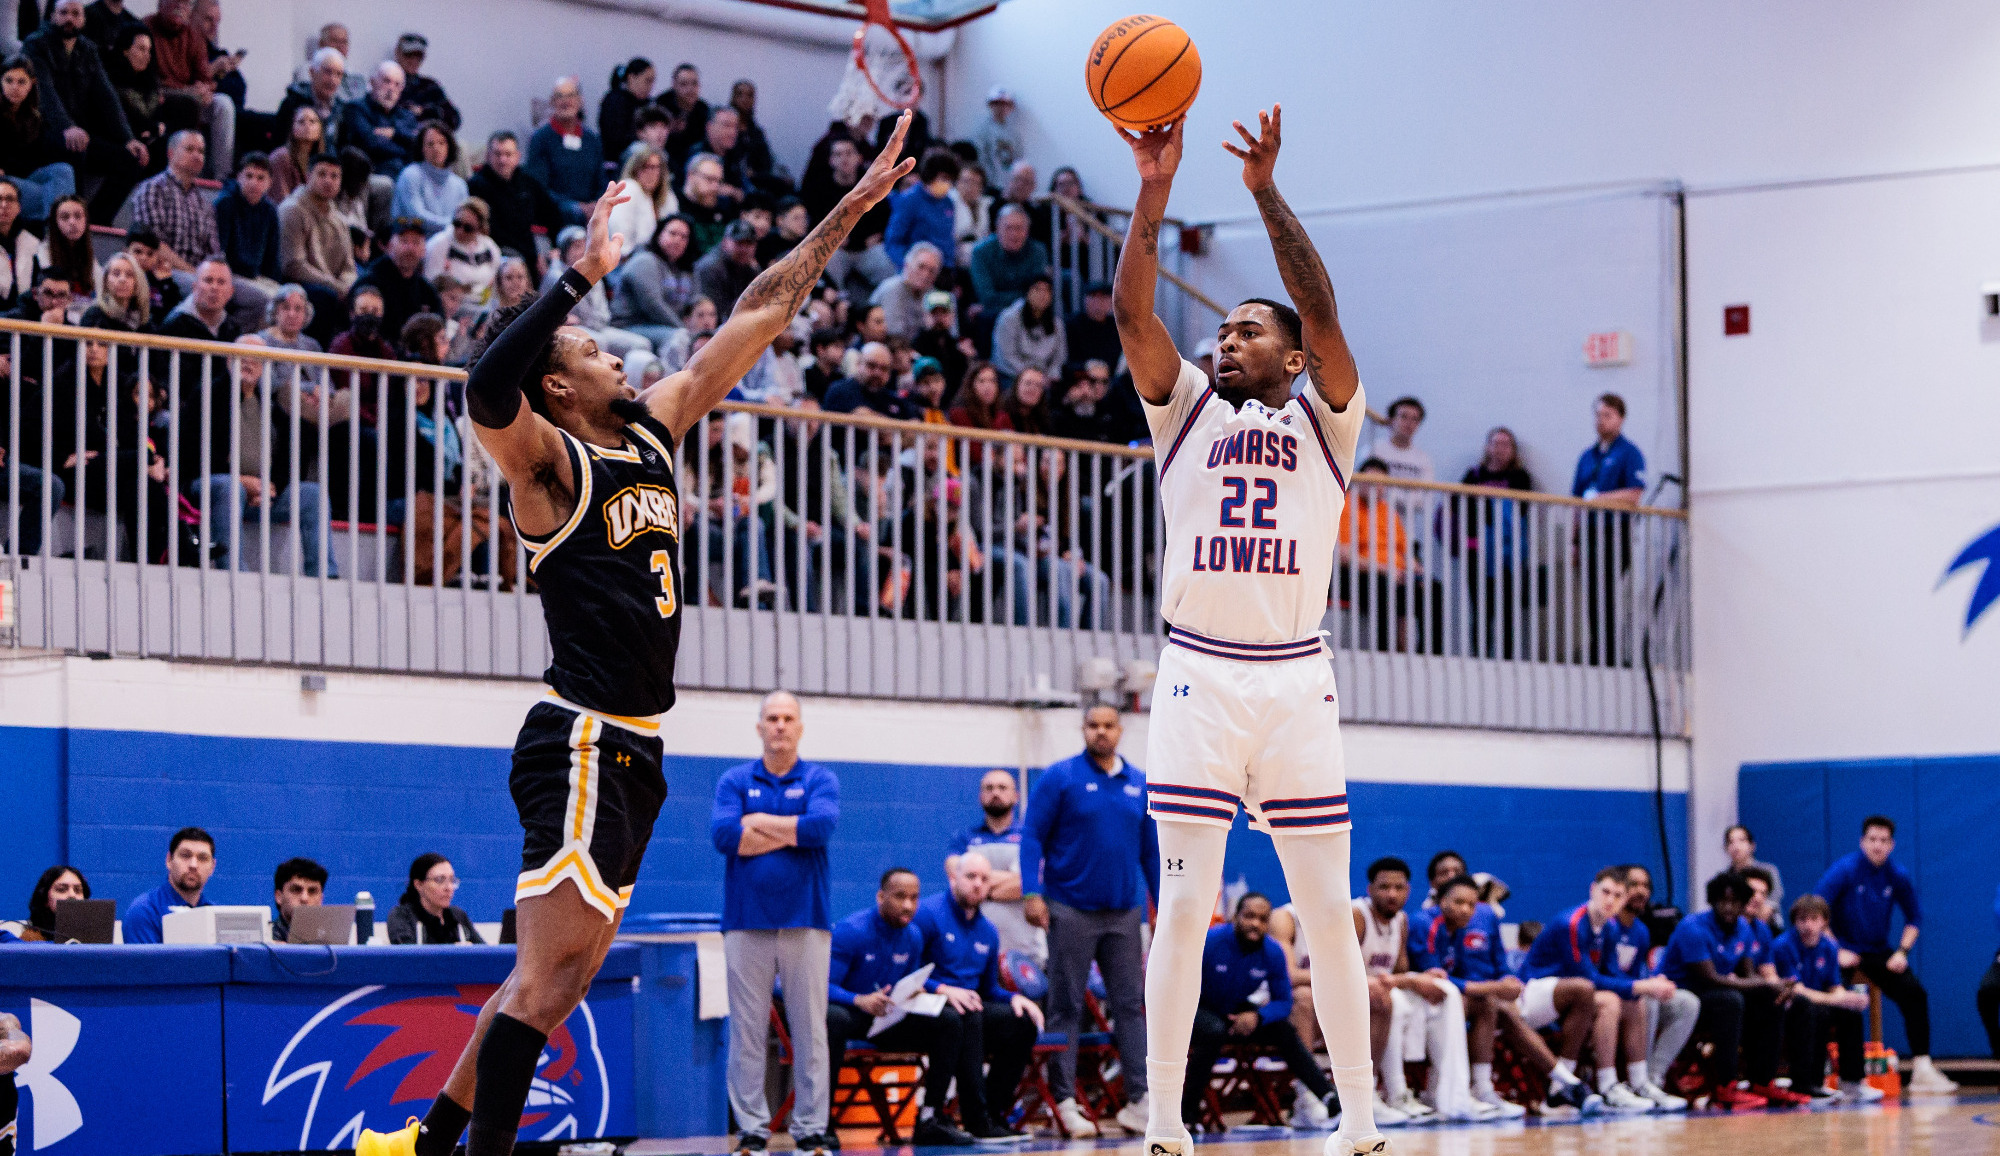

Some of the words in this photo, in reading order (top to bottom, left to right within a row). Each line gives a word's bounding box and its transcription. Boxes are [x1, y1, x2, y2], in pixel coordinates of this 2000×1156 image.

[1207, 428, 1297, 472] UMASS
[1220, 476, 1277, 529] 22
[1193, 536, 1300, 575] LOWELL
[650, 550, 676, 618] 3
